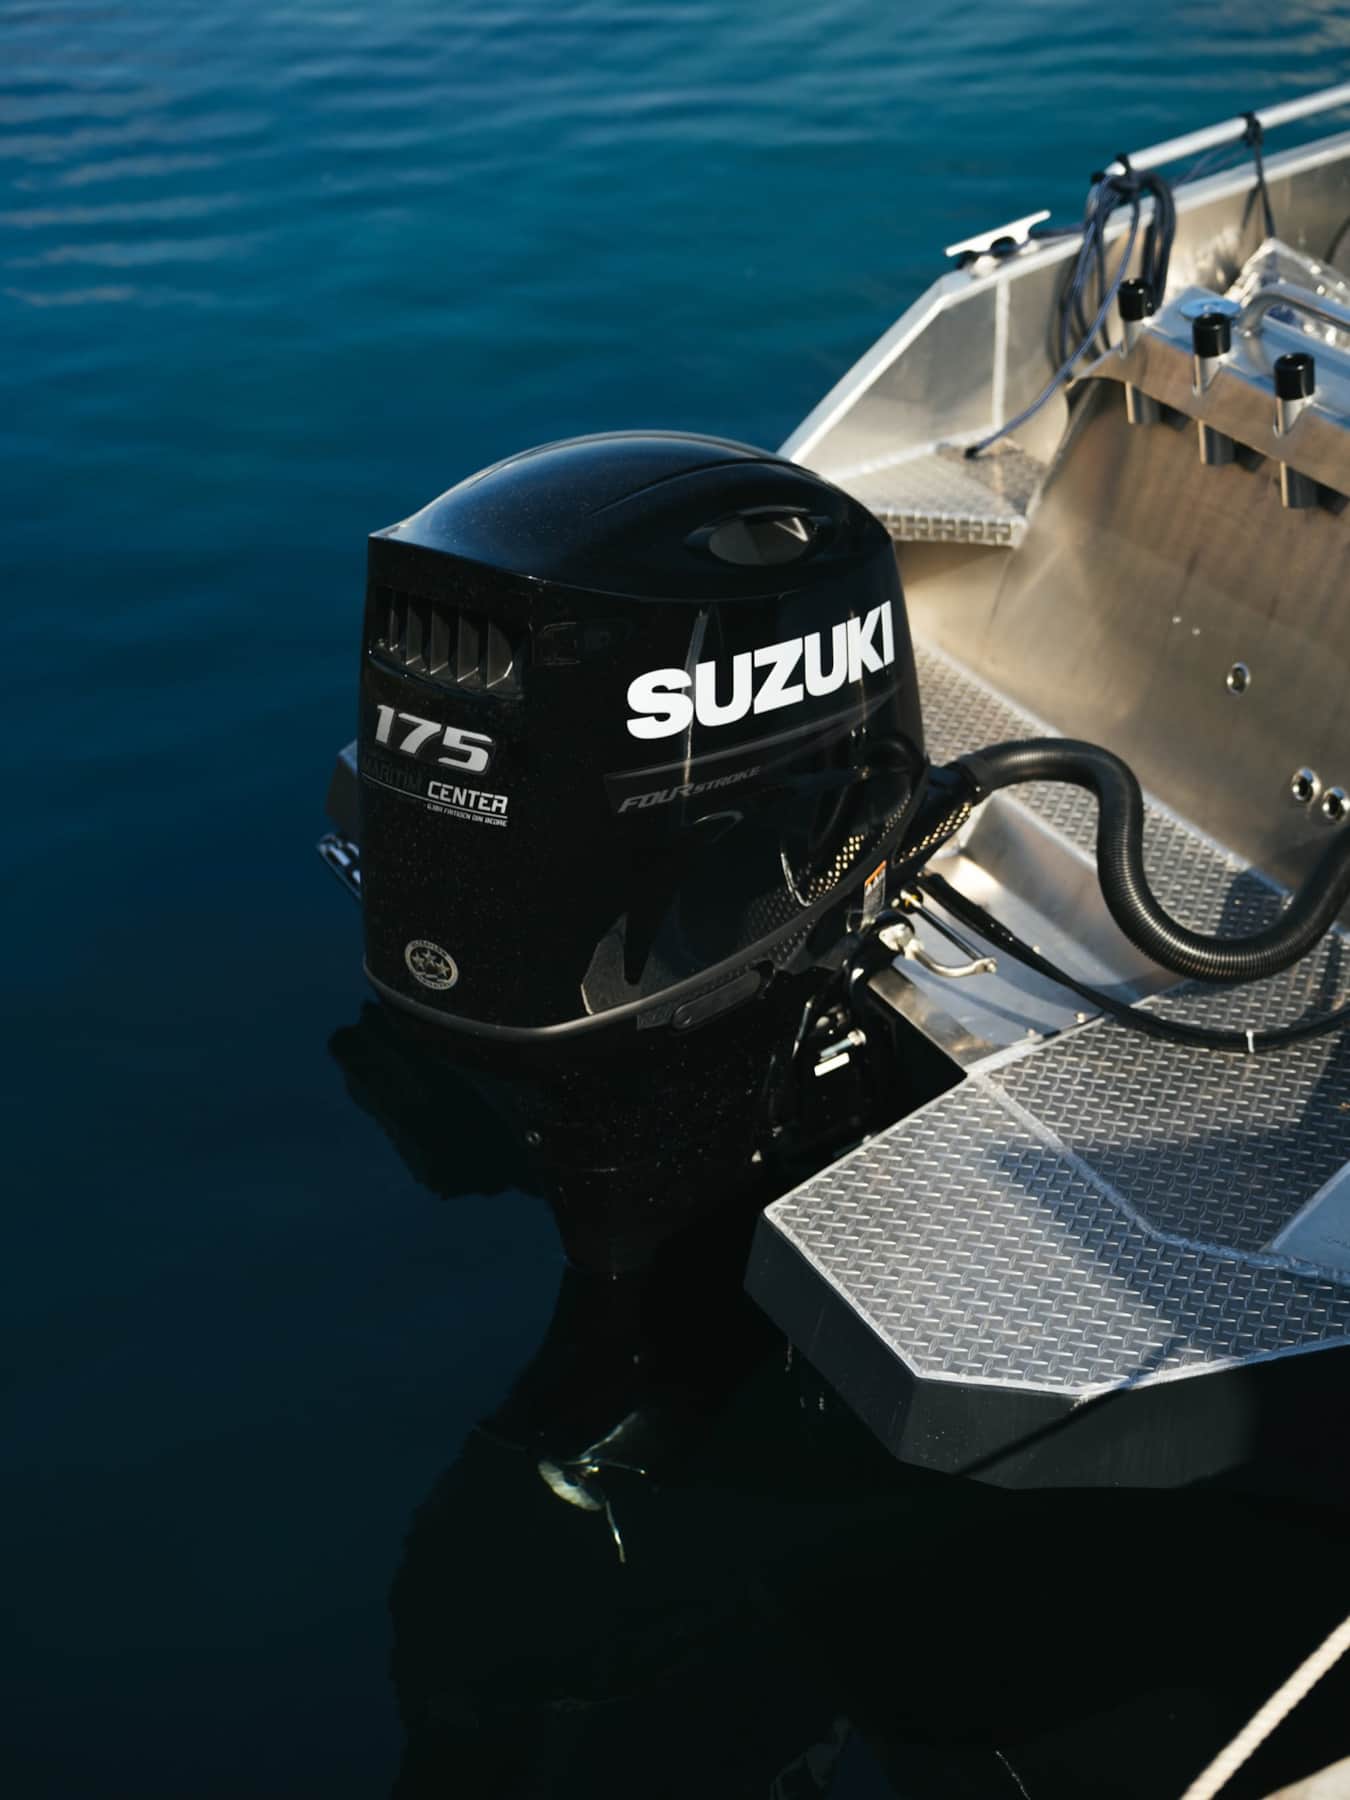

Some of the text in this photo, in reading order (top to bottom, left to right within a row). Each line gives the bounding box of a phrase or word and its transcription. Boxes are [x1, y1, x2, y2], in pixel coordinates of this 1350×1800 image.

[625, 599, 896, 741] SUZUKI
[375, 704, 494, 774] 175
[427, 780, 509, 814] CENTER
[616, 782, 694, 814] FOUR
